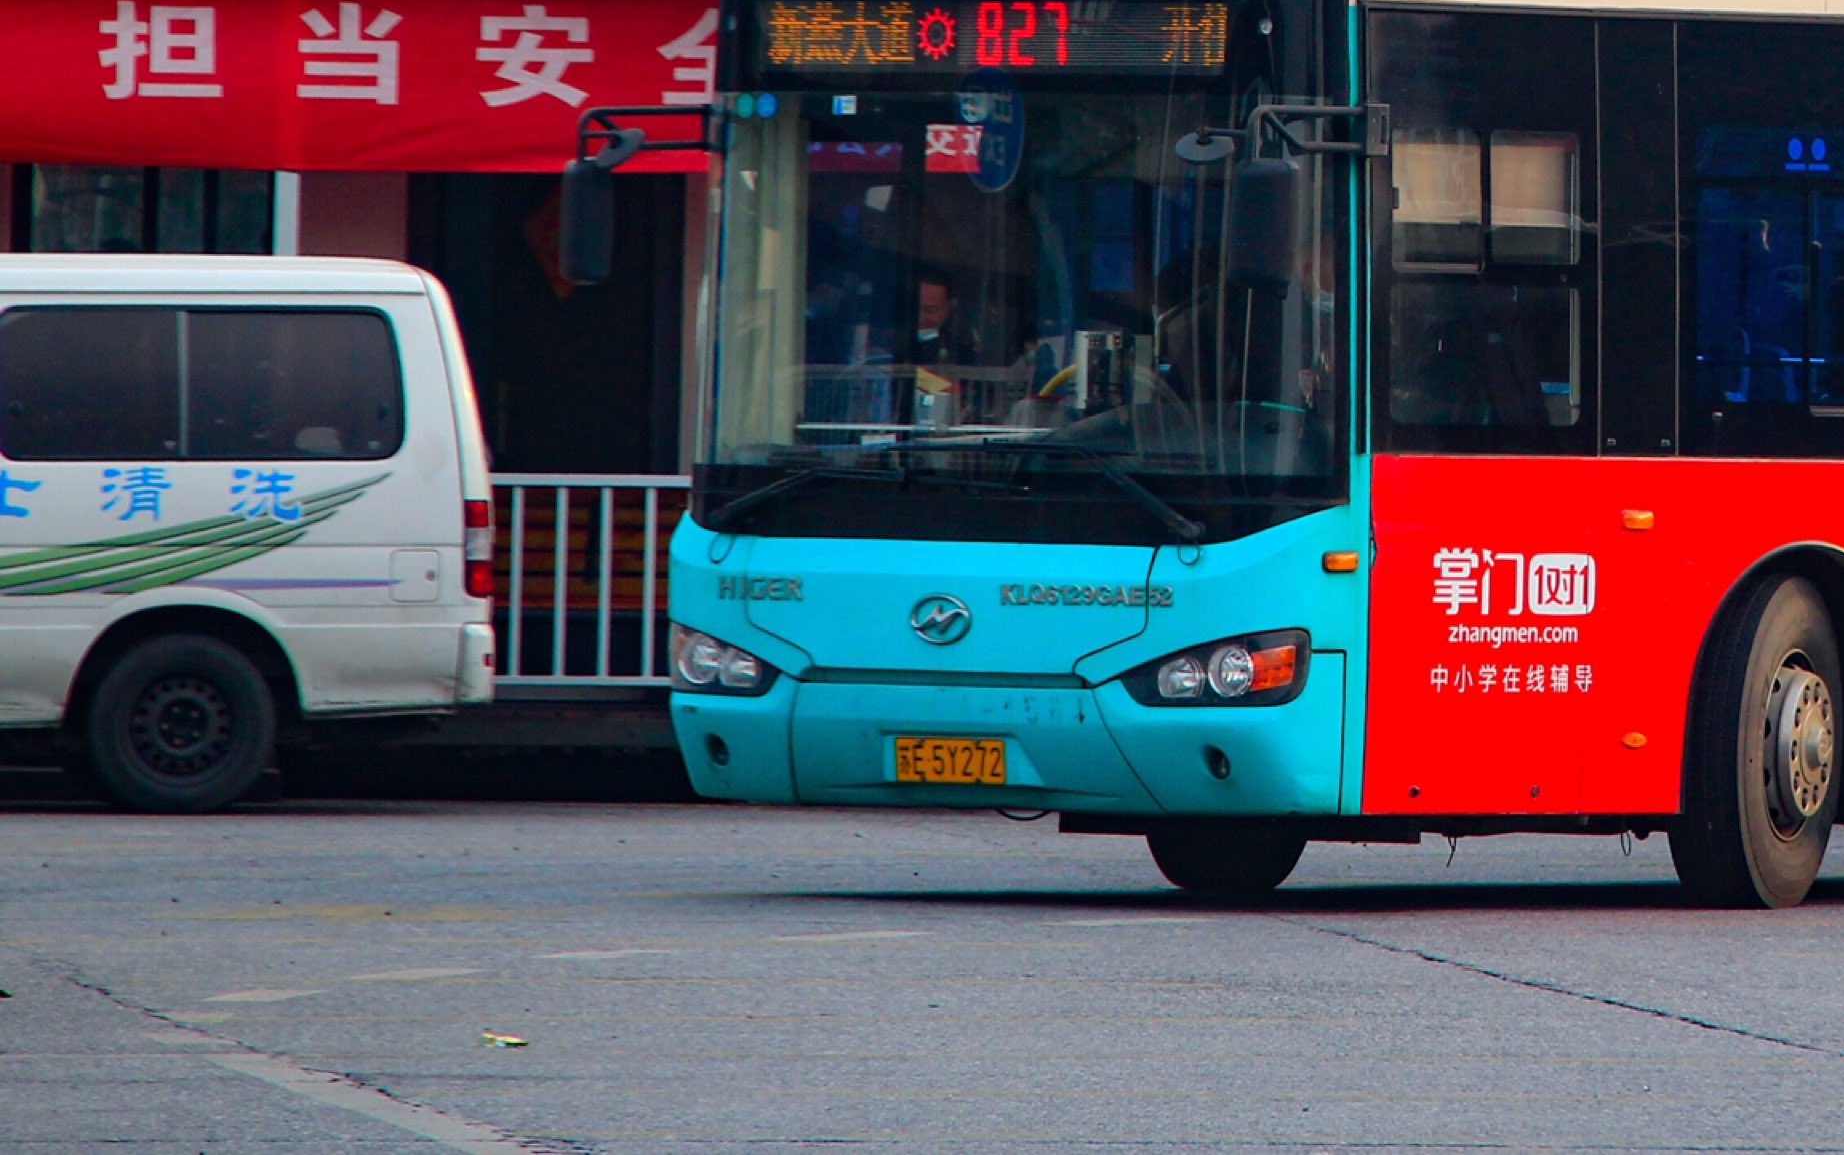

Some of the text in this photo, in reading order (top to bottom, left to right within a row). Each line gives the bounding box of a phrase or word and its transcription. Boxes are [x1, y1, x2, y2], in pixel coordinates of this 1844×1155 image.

[976, 2, 1070, 65] 827
[718, 575, 804, 602] HIGER
[1448, 624, 1579, 649] zhangmen.com
[1430, 664, 1593, 693] 中小学在线辅导
